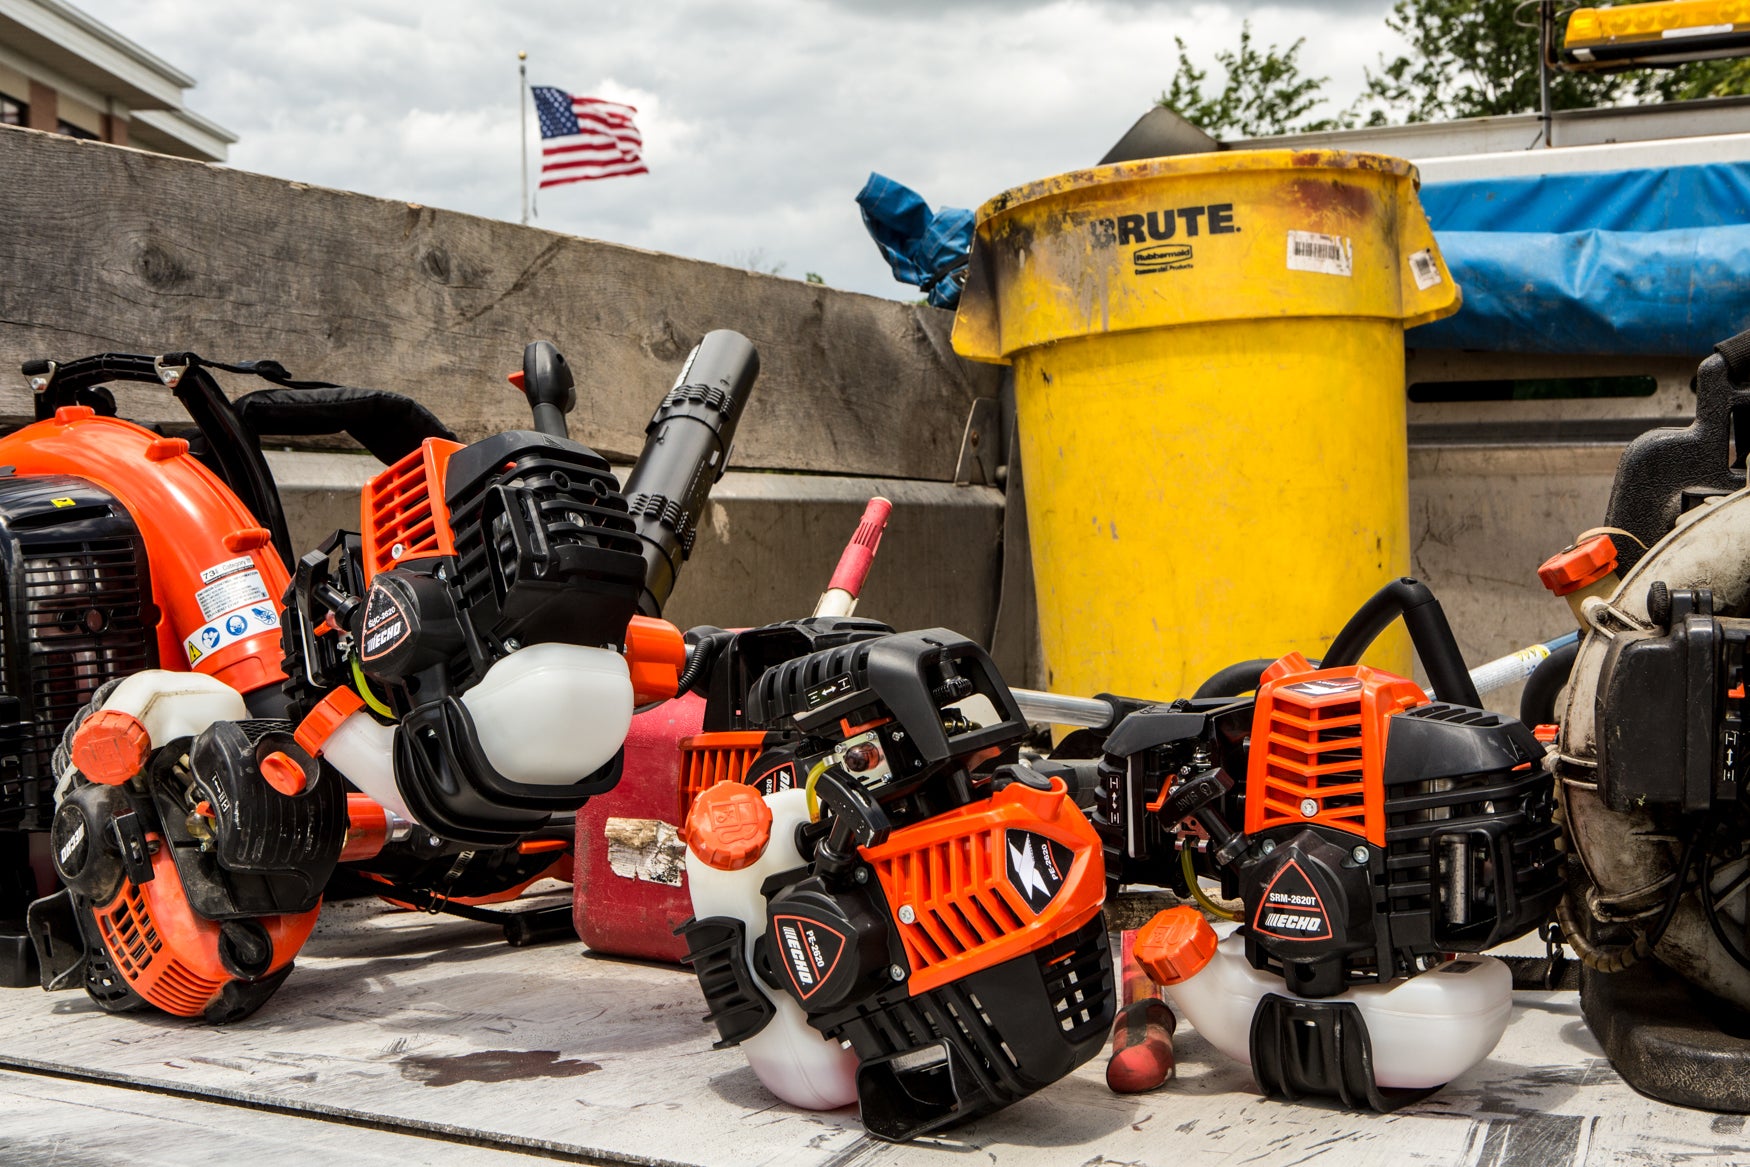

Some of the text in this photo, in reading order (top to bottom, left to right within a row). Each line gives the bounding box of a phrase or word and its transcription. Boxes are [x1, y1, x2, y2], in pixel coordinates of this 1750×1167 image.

[1136, 249, 1190, 261] Rubbermaid
[1041, 843, 1058, 881] PE-2620
[1269, 892, 1317, 905] SRM-2620T
[1275, 914, 1321, 931] ECHO
[787, 937, 814, 984] ECHO
[806, 929, 825, 968] PE-2620
